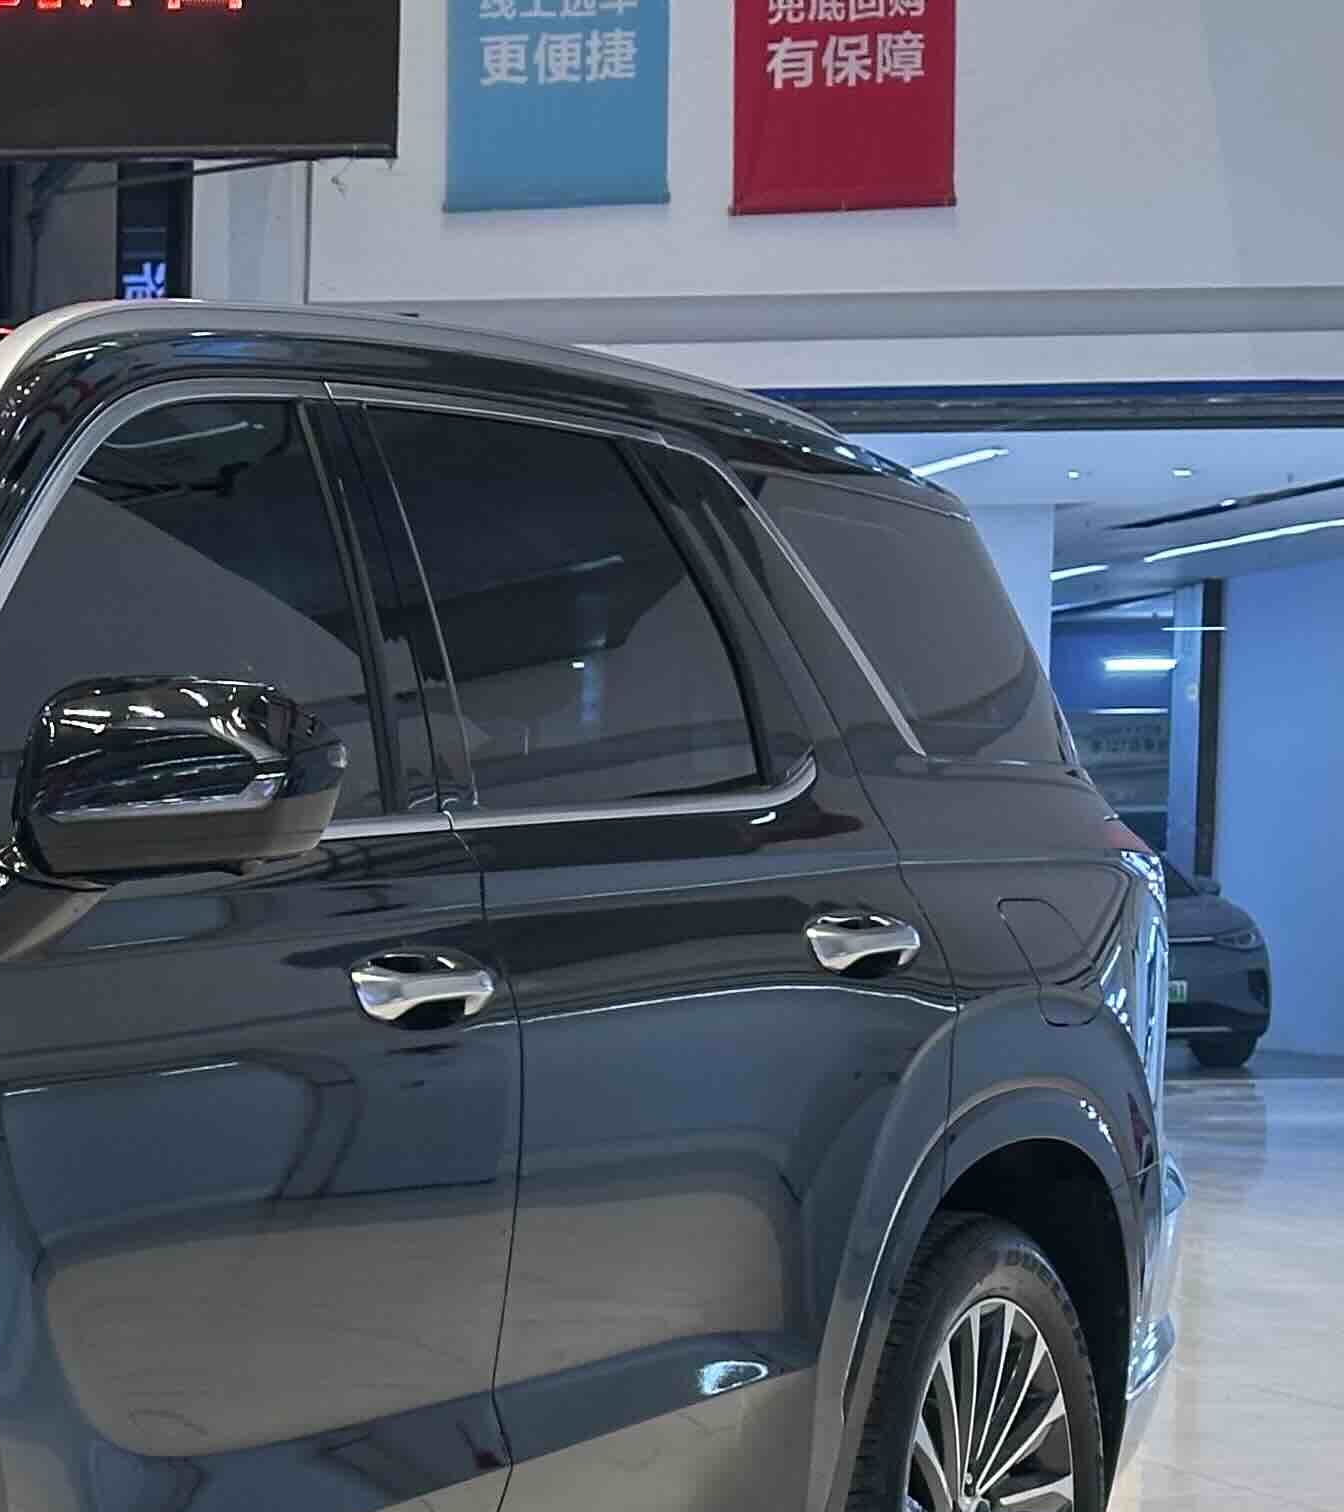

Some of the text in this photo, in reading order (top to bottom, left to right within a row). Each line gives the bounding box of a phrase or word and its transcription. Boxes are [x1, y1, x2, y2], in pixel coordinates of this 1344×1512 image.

[479, 29, 638, 87] 更便捷
[766, 30, 925, 90] 有保障
